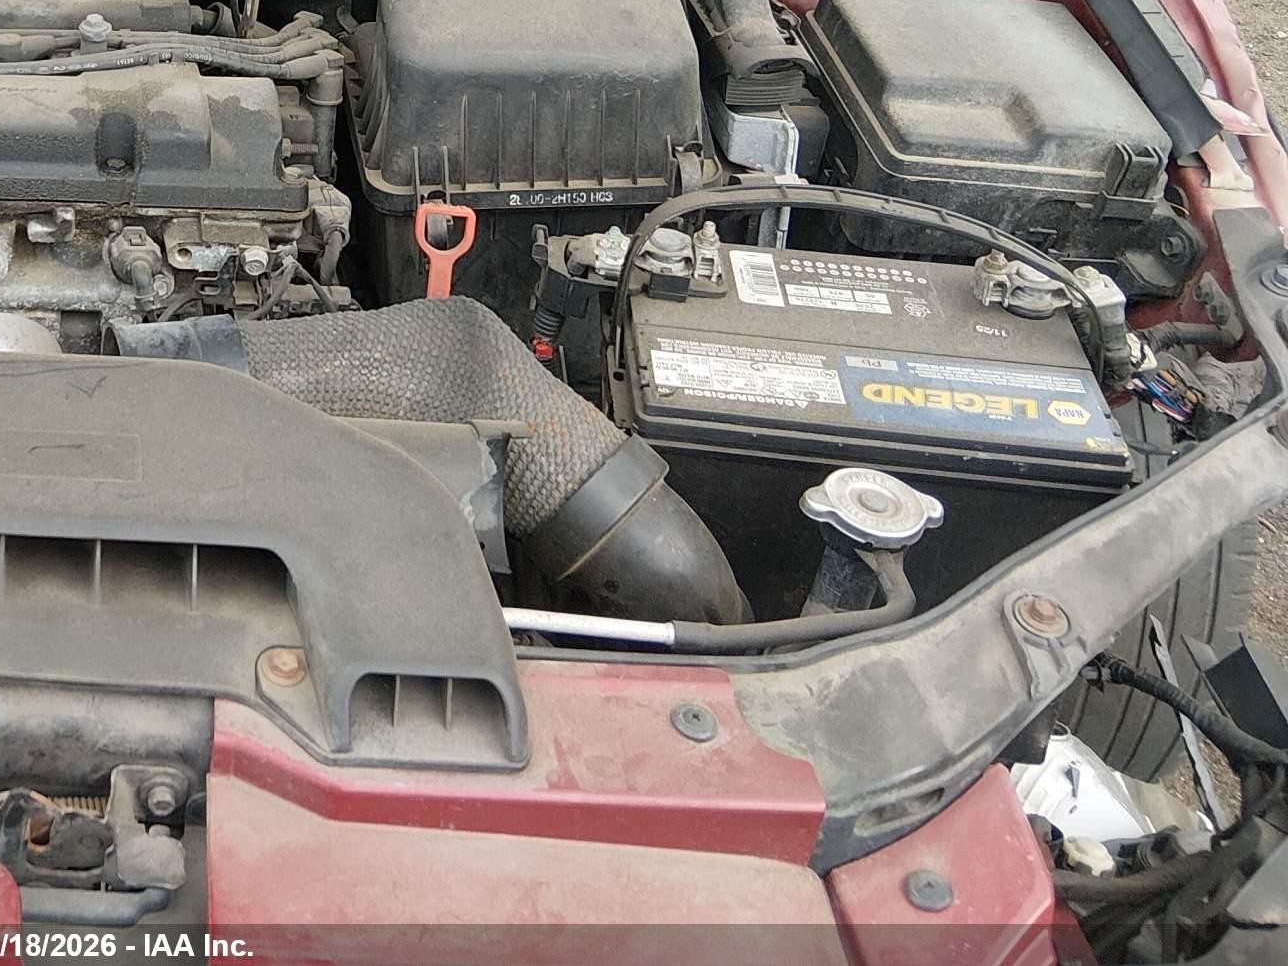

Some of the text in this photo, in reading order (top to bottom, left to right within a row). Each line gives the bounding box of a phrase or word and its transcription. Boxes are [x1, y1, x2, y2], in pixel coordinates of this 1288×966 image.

[509, 192, 586, 206] 200-2H150
[862, 383, 1039, 419] LEGEND
[1054, 407, 1084, 419] NAPA
